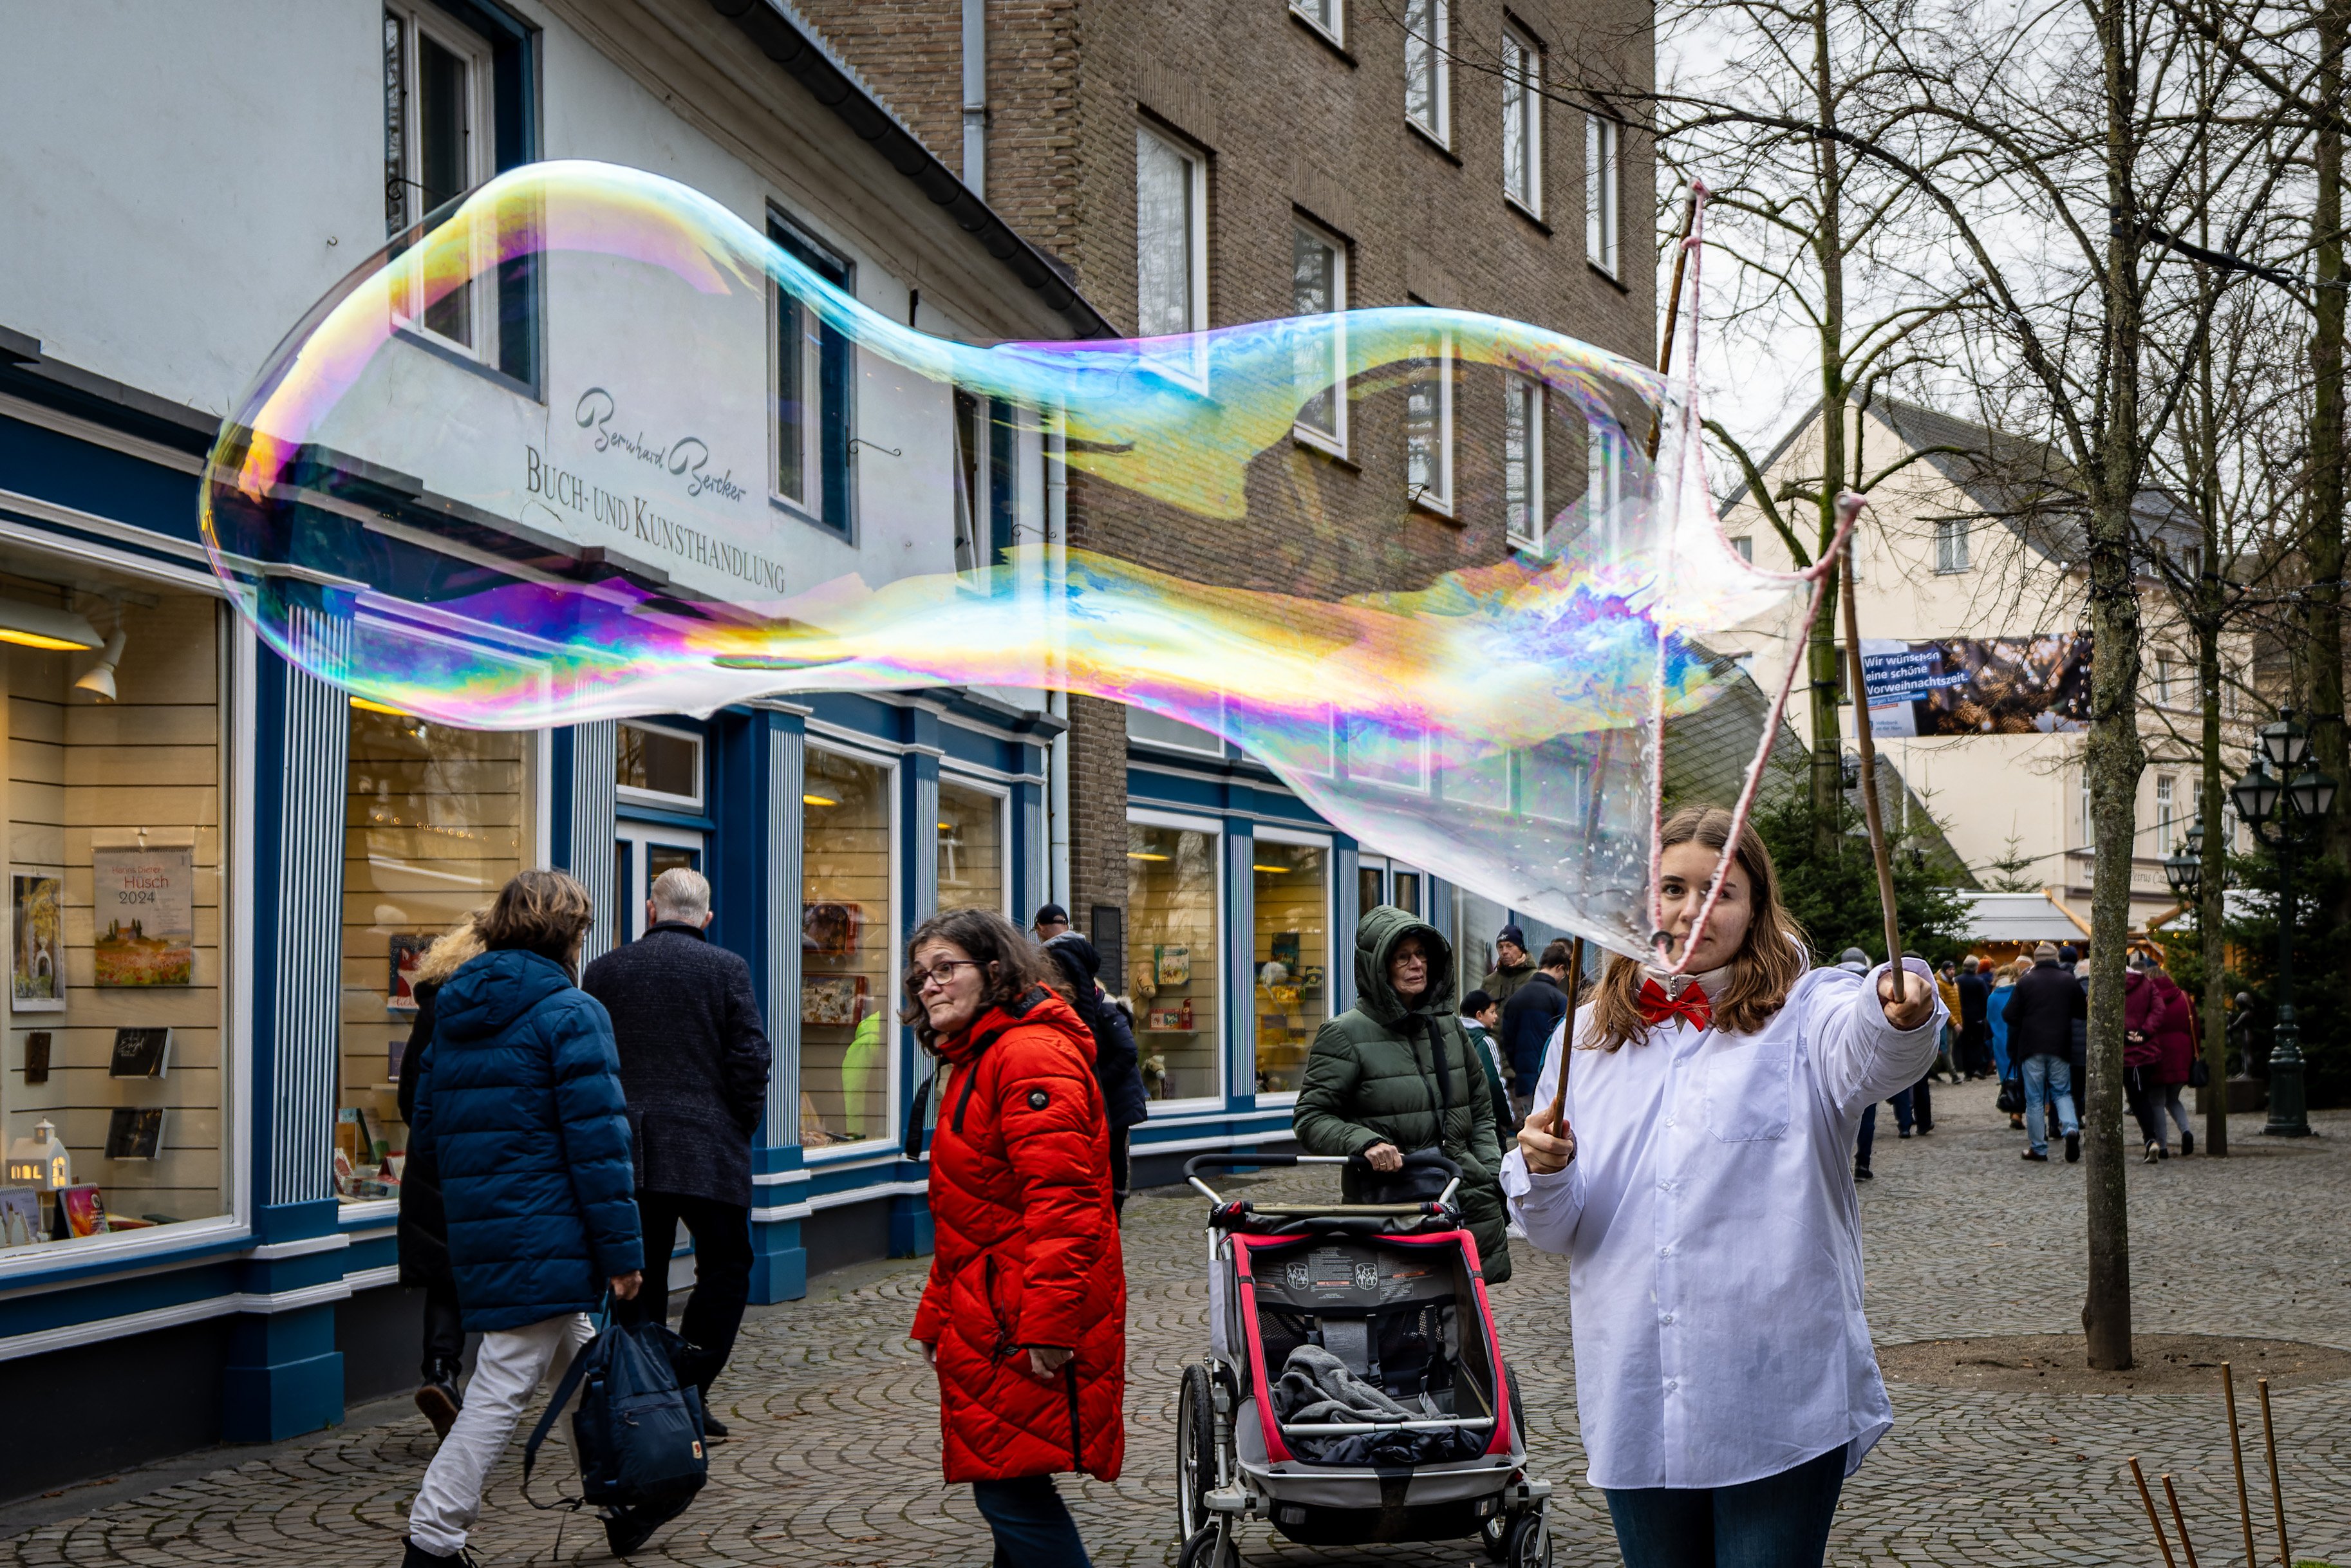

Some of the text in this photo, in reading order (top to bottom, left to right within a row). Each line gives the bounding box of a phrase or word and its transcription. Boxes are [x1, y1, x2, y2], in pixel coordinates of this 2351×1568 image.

[576, 387, 746, 503] Bernhard Bercker
[594, 487, 628, 531] UND
[633, 496, 784, 593] KUNSTHANDLUNG
[1864, 651, 1940, 667] Wir wünschen
[1866, 666, 1927, 682] eine schöne
[1867, 673, 1969, 695] Vorweihnachtszeit.
[124, 875, 169, 889] Hüsch
[119, 890, 155, 904] 2024
